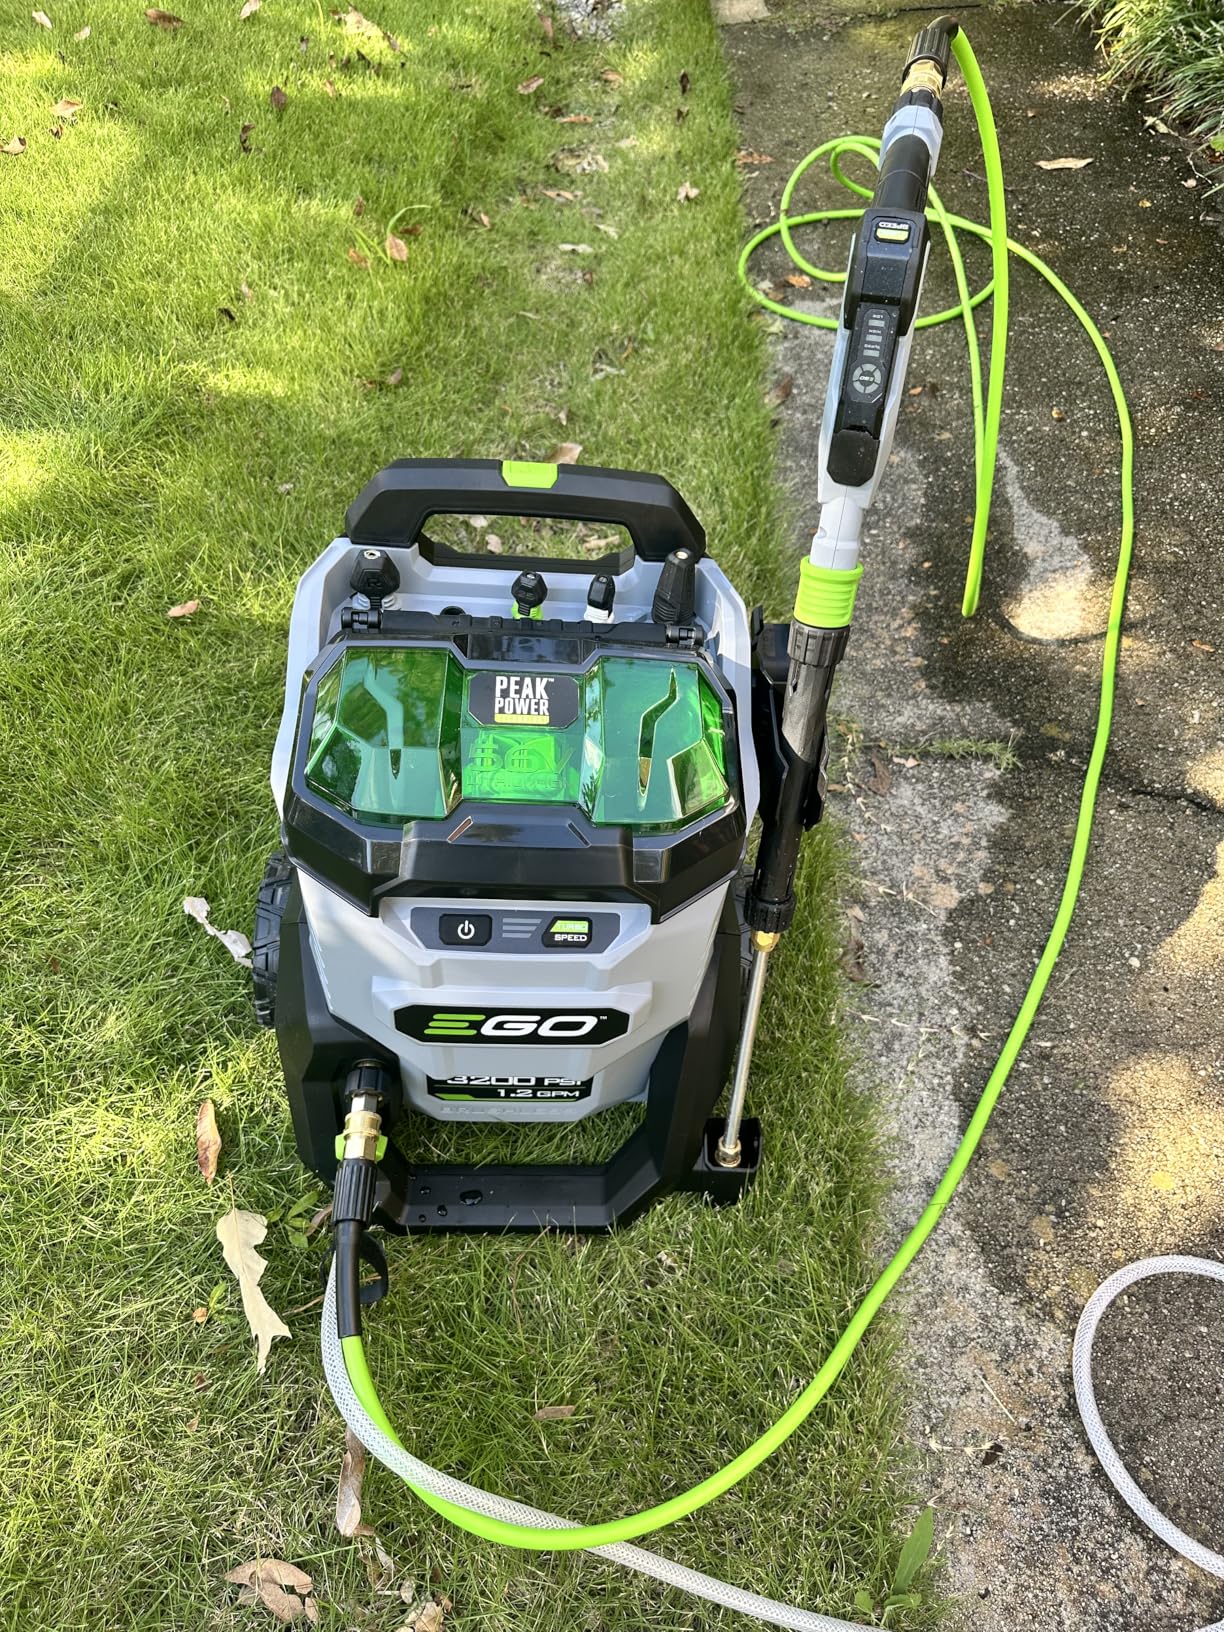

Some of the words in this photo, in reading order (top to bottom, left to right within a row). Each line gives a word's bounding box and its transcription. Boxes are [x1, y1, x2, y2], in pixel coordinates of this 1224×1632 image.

[494, 697, 550, 716] POWER
[554, 934, 588, 942] SPEED
[446, 1075, 536, 1086] 3200
[543, 1077, 581, 1086] PSI
[497, 1088, 533, 1098] 1.2
[536, 1090, 580, 1098] GPM
